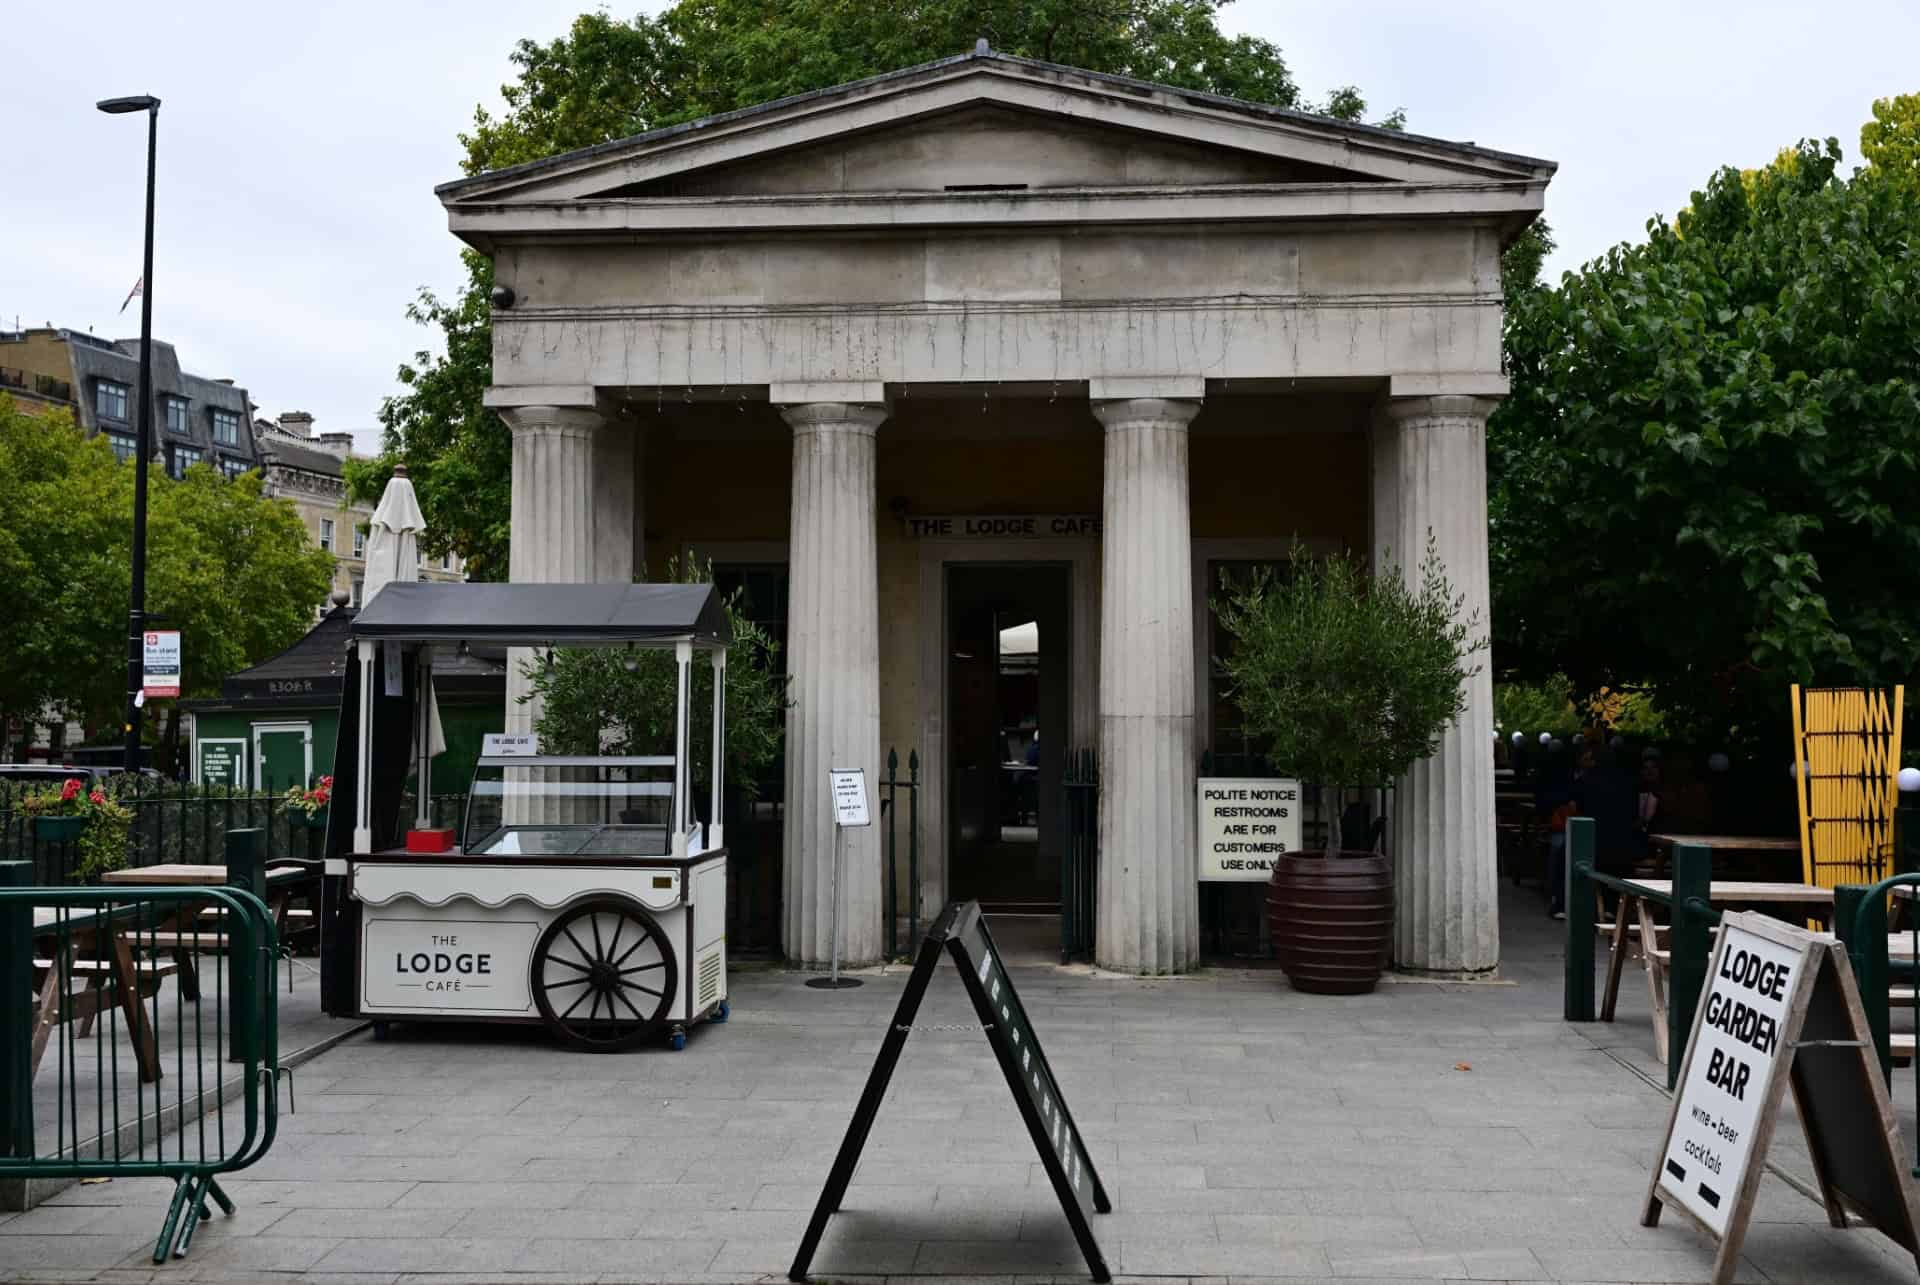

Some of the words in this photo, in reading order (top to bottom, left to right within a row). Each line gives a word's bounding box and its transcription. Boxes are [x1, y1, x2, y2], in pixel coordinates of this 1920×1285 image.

[909, 519, 952, 535] THE
[966, 519, 1035, 535] LODGE
[1205, 790, 1248, 800] POLITE
[1250, 790, 1296, 800] NOTICE
[1214, 807, 1288, 817] RESTROOMS
[1223, 825, 1249, 835] ARE
[1252, 825, 1277, 835] FOR
[1214, 843, 1285, 853] CUSTOMERS
[1221, 860, 1245, 870] USE
[431, 935, 458, 946] THE
[396, 952, 491, 974] LODGE
[1720, 944, 1790, 1002] LODGE
[425, 978, 462, 992] CAFÉ
[1705, 992, 1782, 1057] GARDEN
[1706, 1048, 1750, 1101] BAR
[1718, 1116, 1739, 1145] beer
[1684, 1139, 1722, 1175] cocktails
